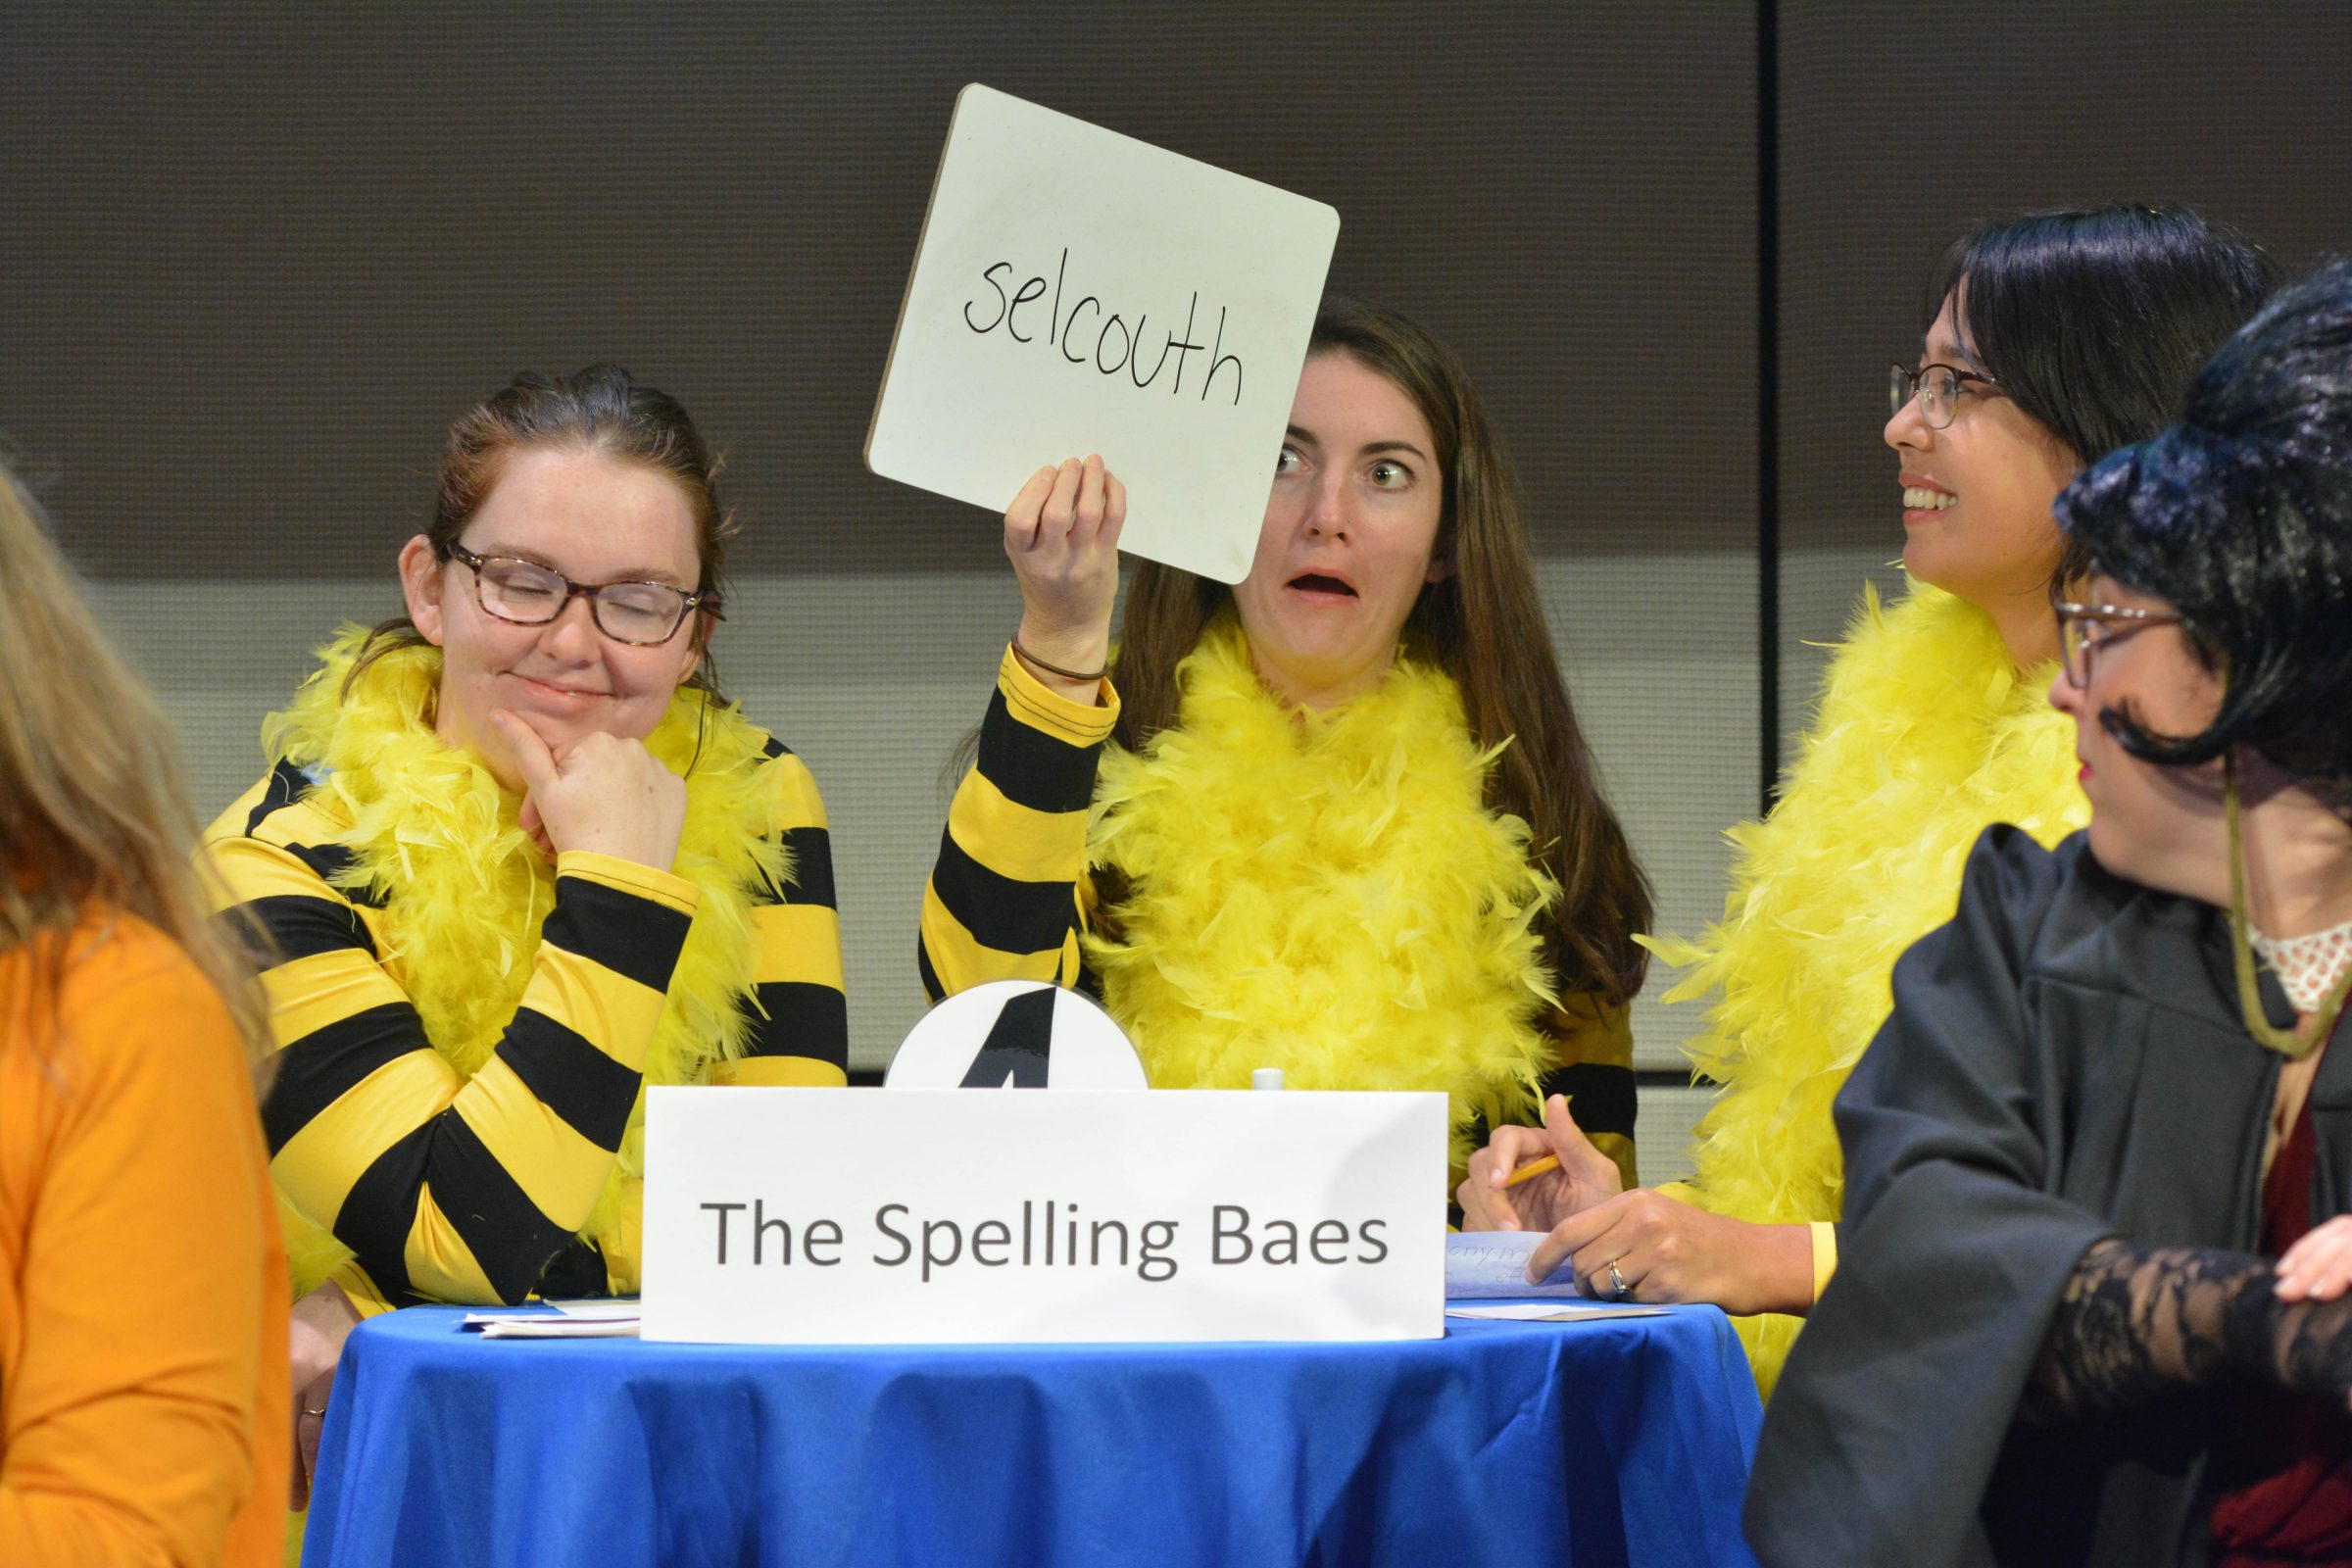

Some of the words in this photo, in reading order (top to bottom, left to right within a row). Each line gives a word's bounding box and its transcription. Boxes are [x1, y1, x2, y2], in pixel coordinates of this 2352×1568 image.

[963, 247, 1242, 406] selcouth
[700, 1199, 843, 1266] The
[873, 1200, 1179, 1283] Spelling
[1212, 1203, 1388, 1265] Baes
